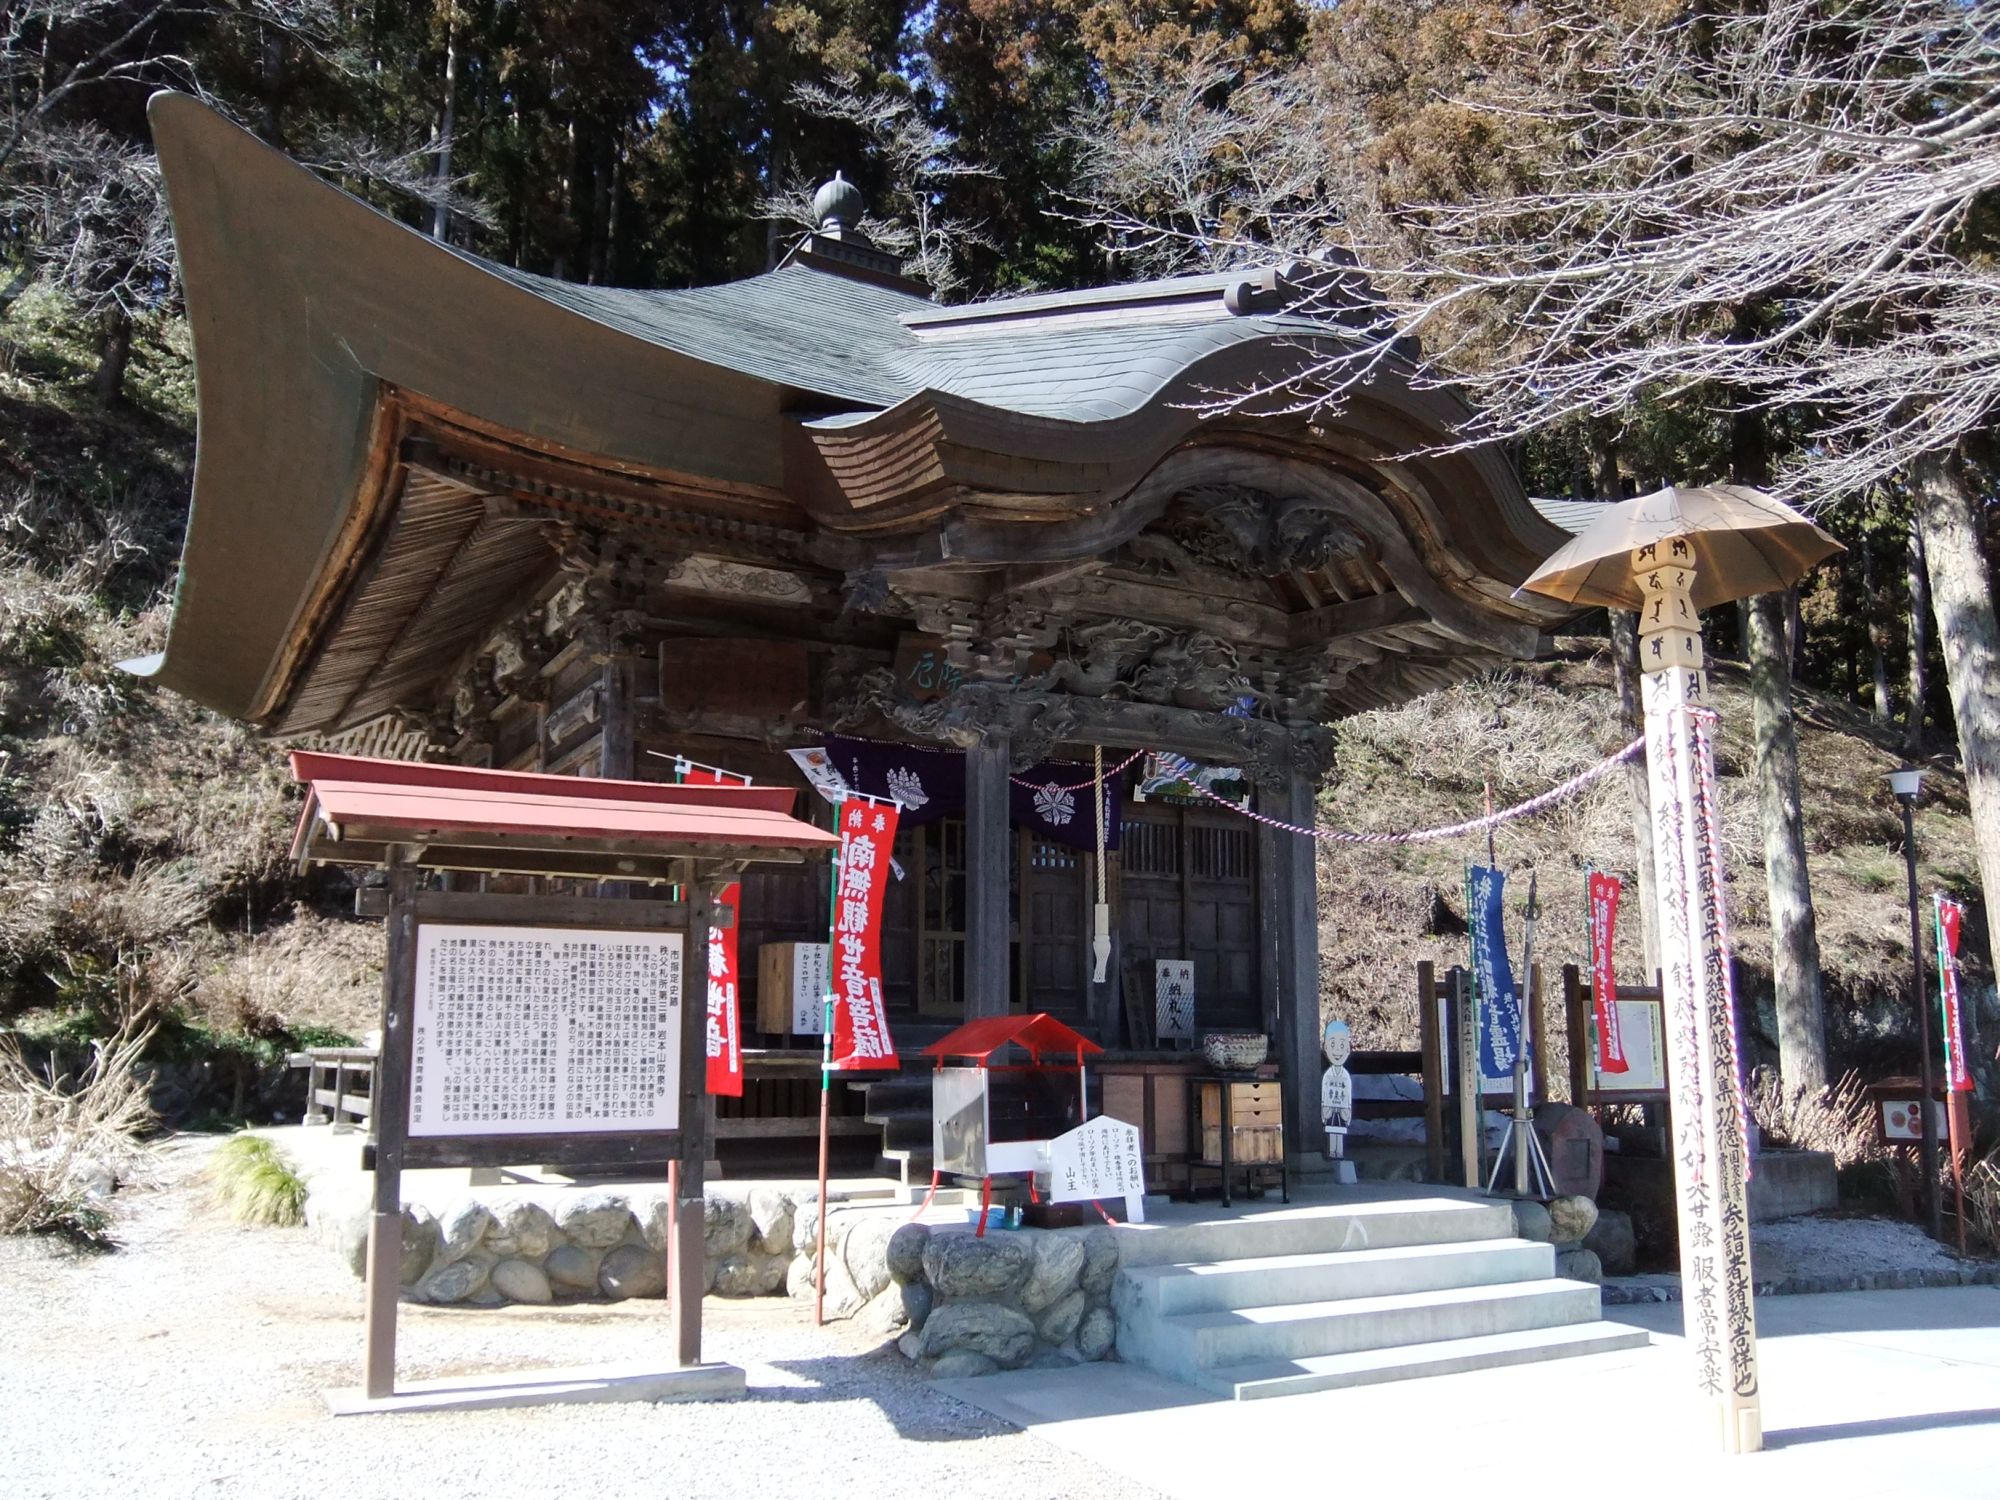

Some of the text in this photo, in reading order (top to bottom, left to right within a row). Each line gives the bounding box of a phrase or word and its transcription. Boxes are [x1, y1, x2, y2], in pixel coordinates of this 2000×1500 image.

[669, 949, 679, 1007] 市指定史跡
[1168, 982, 1182, 1031] 納札入
[656, 945, 669, 1097] 秩父札所第三番 岩本山常泉寺
[413, 1027, 425, 1123] 秩父市教育委員会指定
[1065, 1166, 1078, 1192] 山主
[1125, 1128, 1140, 1190] 参拝者へのお願い
